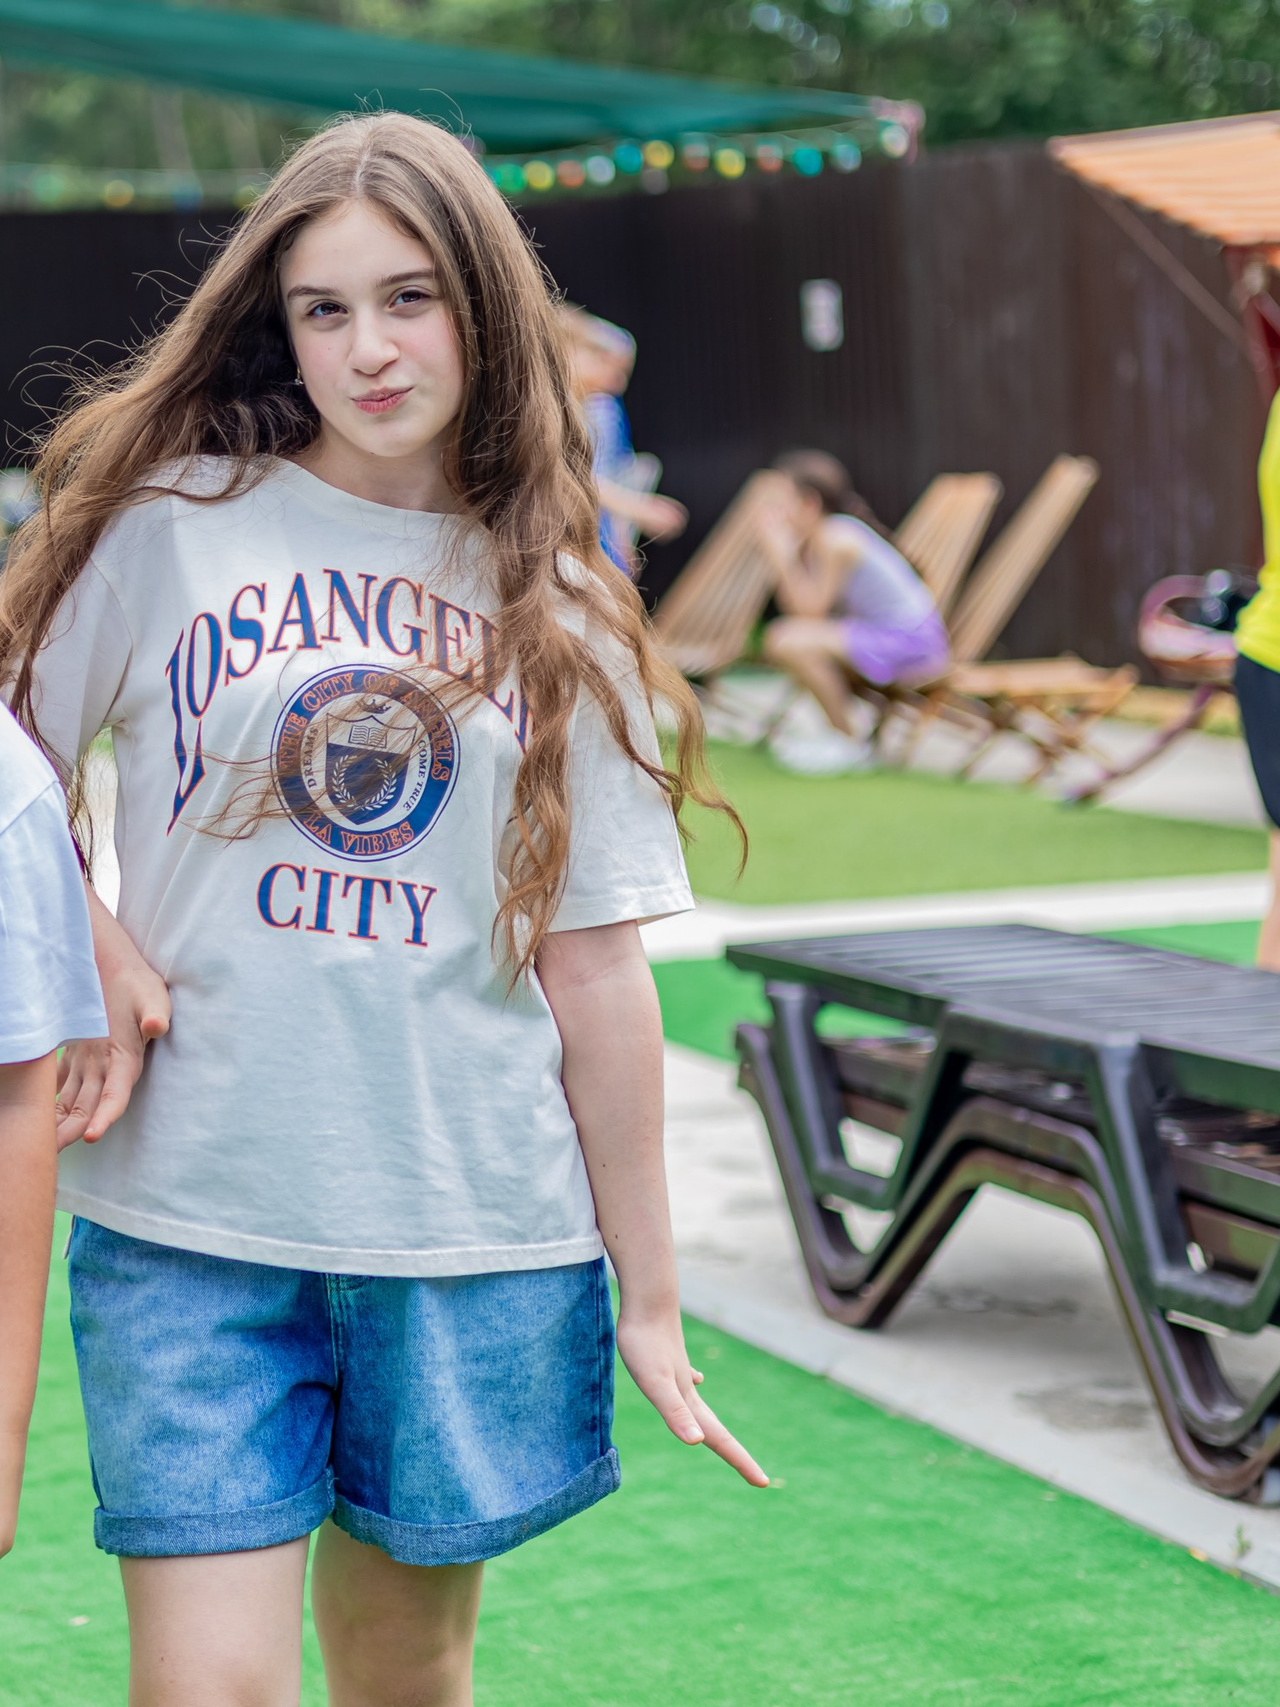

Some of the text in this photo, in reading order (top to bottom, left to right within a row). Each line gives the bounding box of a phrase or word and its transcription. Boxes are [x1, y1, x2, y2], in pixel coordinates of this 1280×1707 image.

[301, 672, 355, 711] CITY
[303, 727, 428, 812] DREAMS COME TRUE
[303, 811, 415, 855] LA VIBES
[256, 861, 438, 948] CITY
